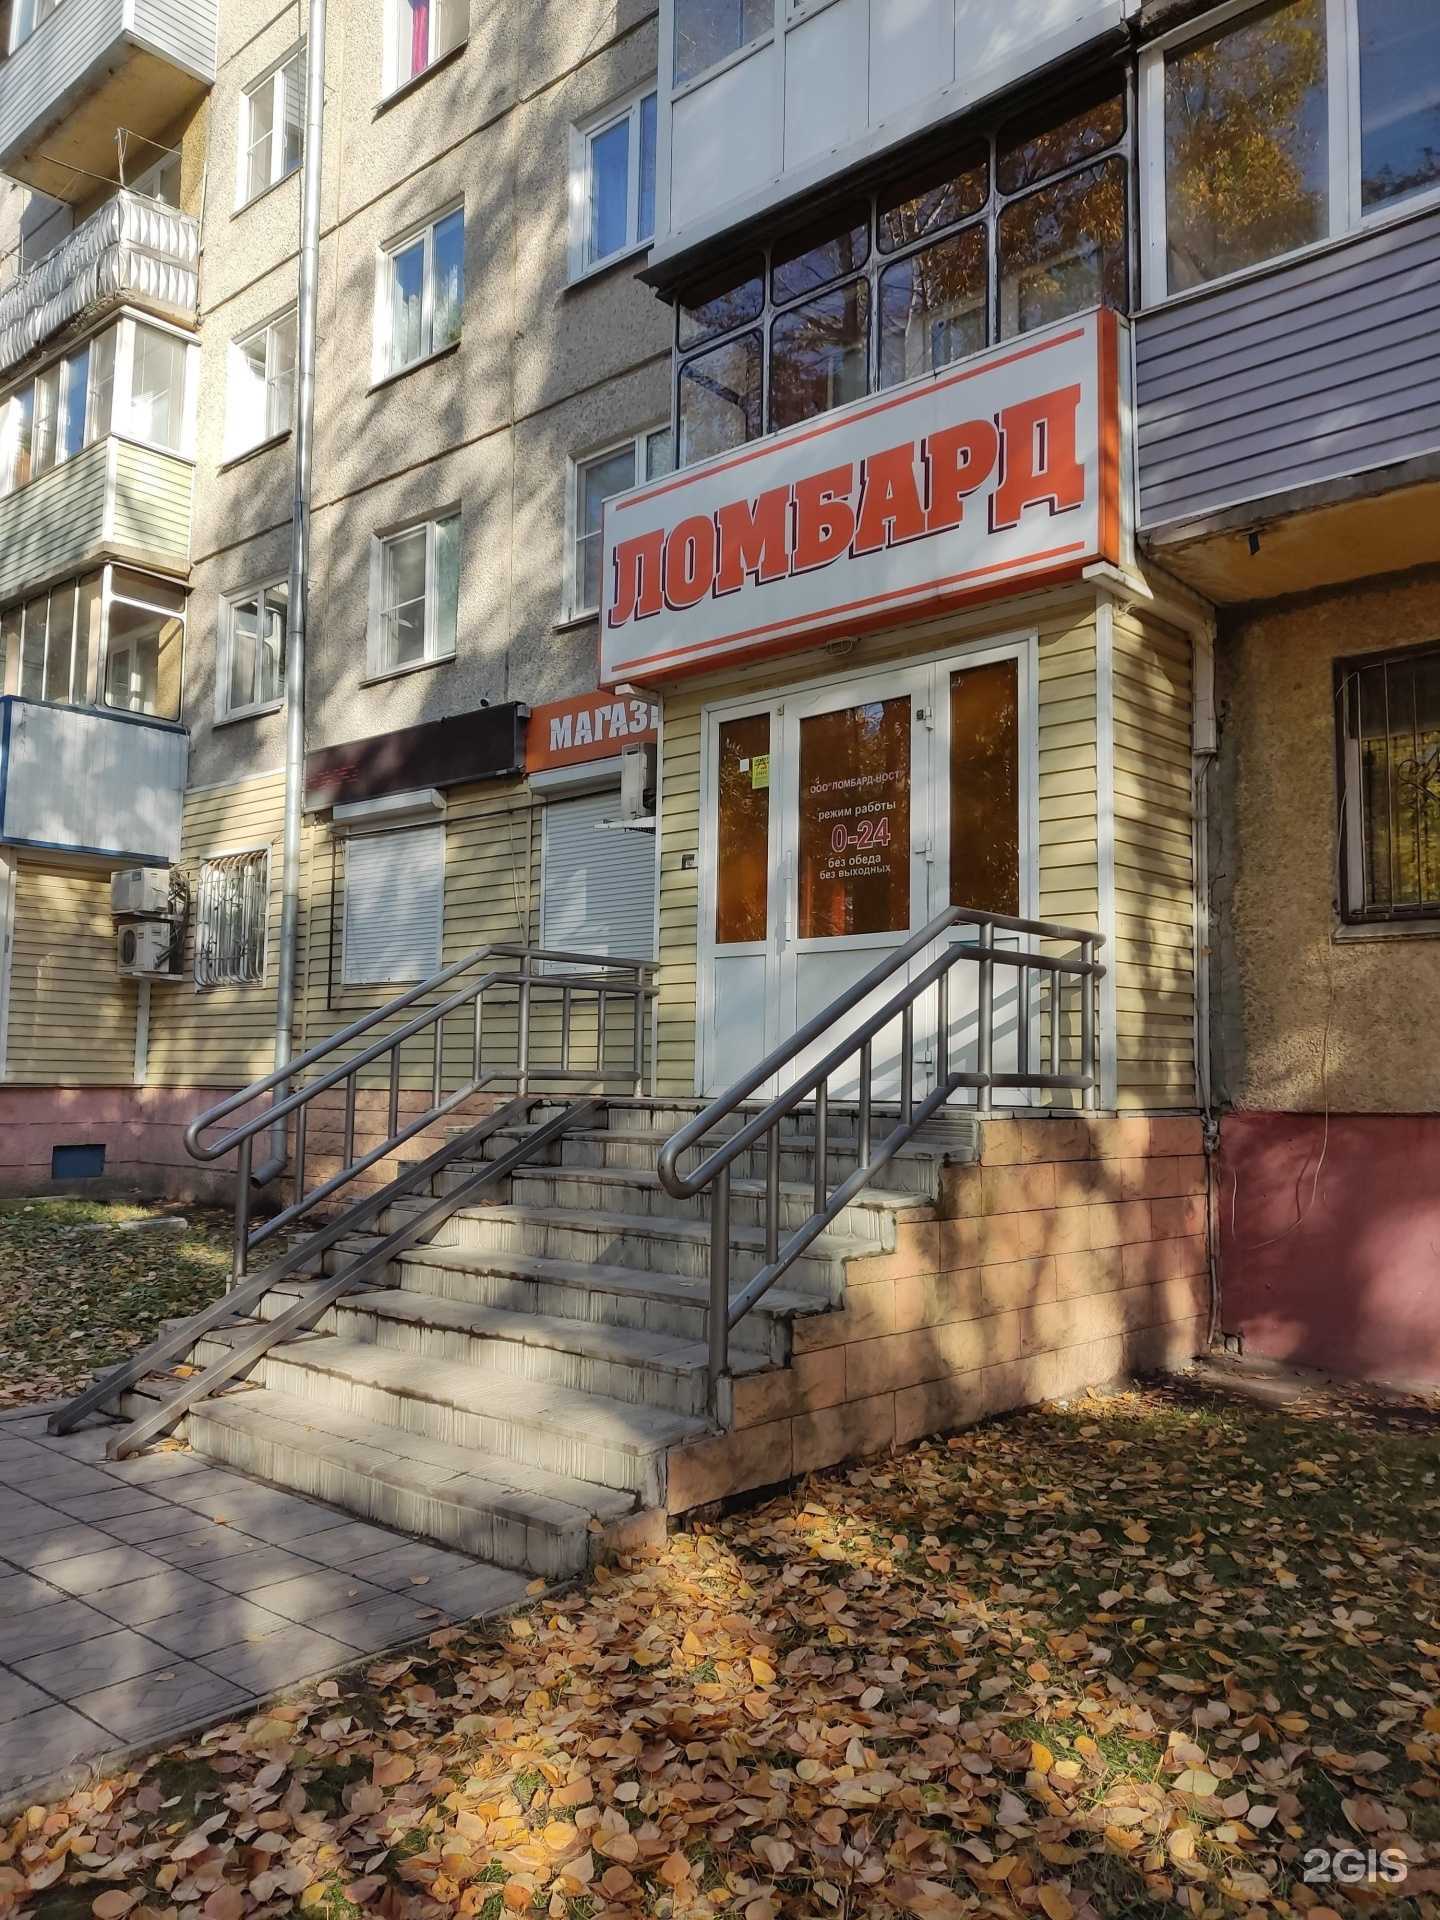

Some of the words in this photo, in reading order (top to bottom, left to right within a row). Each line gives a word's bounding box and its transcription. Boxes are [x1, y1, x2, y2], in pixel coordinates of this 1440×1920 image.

[608, 384, 1085, 629] ЛОМБАРД
[818, 808, 852, 822] режим
[855, 801, 896, 817] работы
[831, 817, 891, 853] 0-24
[828, 857, 846, 868] без
[849, 854, 881, 867] обеда
[819, 870, 836, 880] без
[838, 864, 891, 878] выходных
